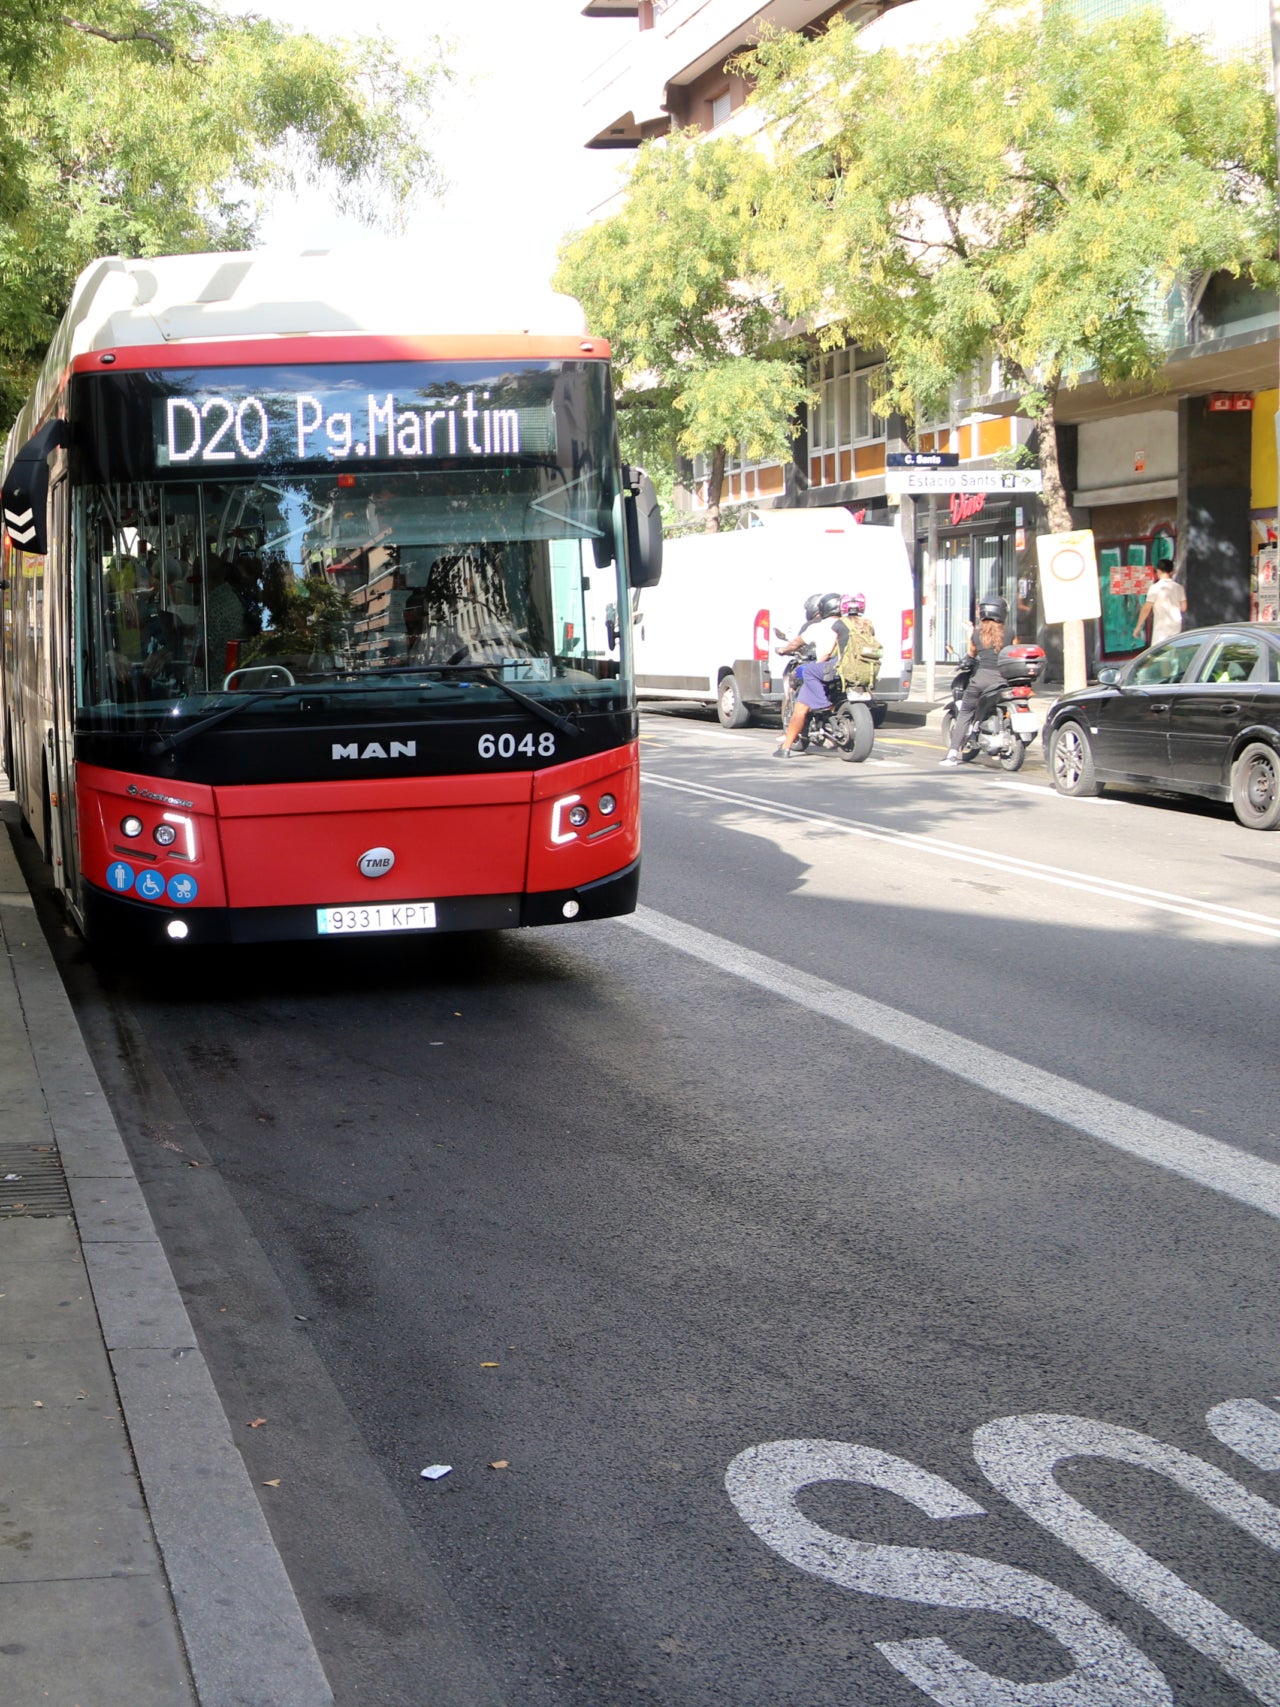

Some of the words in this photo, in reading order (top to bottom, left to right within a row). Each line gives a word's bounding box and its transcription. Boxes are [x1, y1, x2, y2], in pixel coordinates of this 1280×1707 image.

[166, 396, 269, 461] D20
[904, 455, 915, 464] C.
[916, 454, 942, 465] Sants
[960, 474, 997, 487] Sants
[331, 740, 417, 760] MAN
[477, 732, 556, 758] 6048
[365, 858, 390, 868] TMB
[332, 909, 382, 929] 9331
[391, 906, 429, 926] KPT
